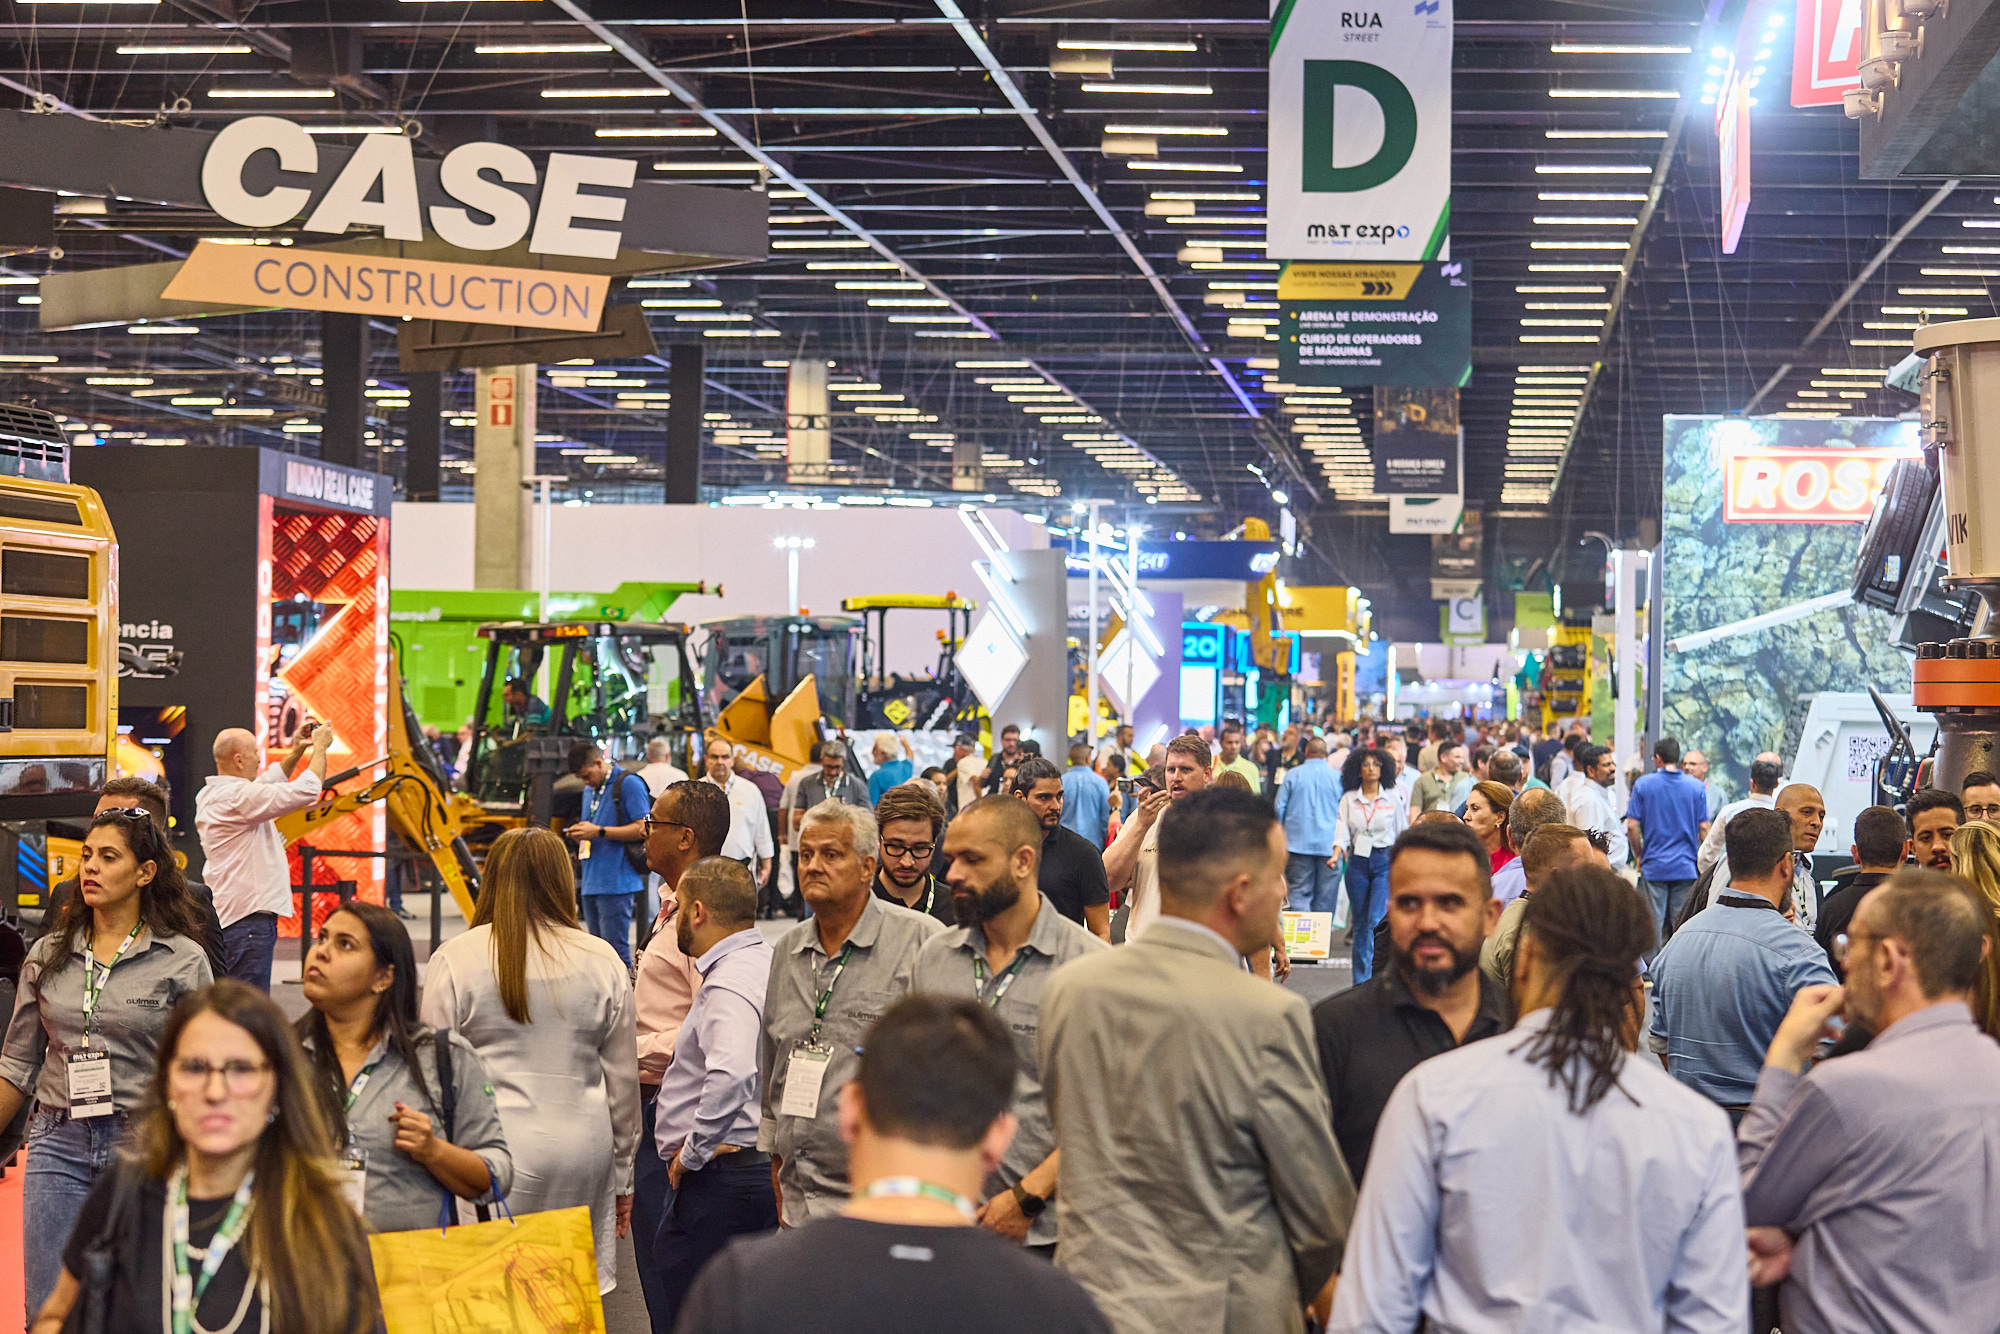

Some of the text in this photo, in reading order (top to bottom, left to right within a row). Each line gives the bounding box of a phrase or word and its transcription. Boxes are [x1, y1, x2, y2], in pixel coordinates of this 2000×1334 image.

[1341, 12, 1383, 28] RUA
[1343, 33, 1380, 43] STREET
[1303, 59, 1418, 193] D
[202, 116, 638, 260] CASE
[254, 259, 591, 319] CONSTRUCTION
[1299, 309, 1438, 325] ARENA DE DEMONSTRAÇÃO
[1299, 333, 1422, 345] CURSO DE OPERADORES
[1299, 344, 1373, 357] DE MÁQUINAS
[286, 460, 374, 510] MUNDO REAL CASE
[1456, 599, 1474, 621] C
[119, 619, 173, 640] ncia
[732, 744, 785, 776] CASE
